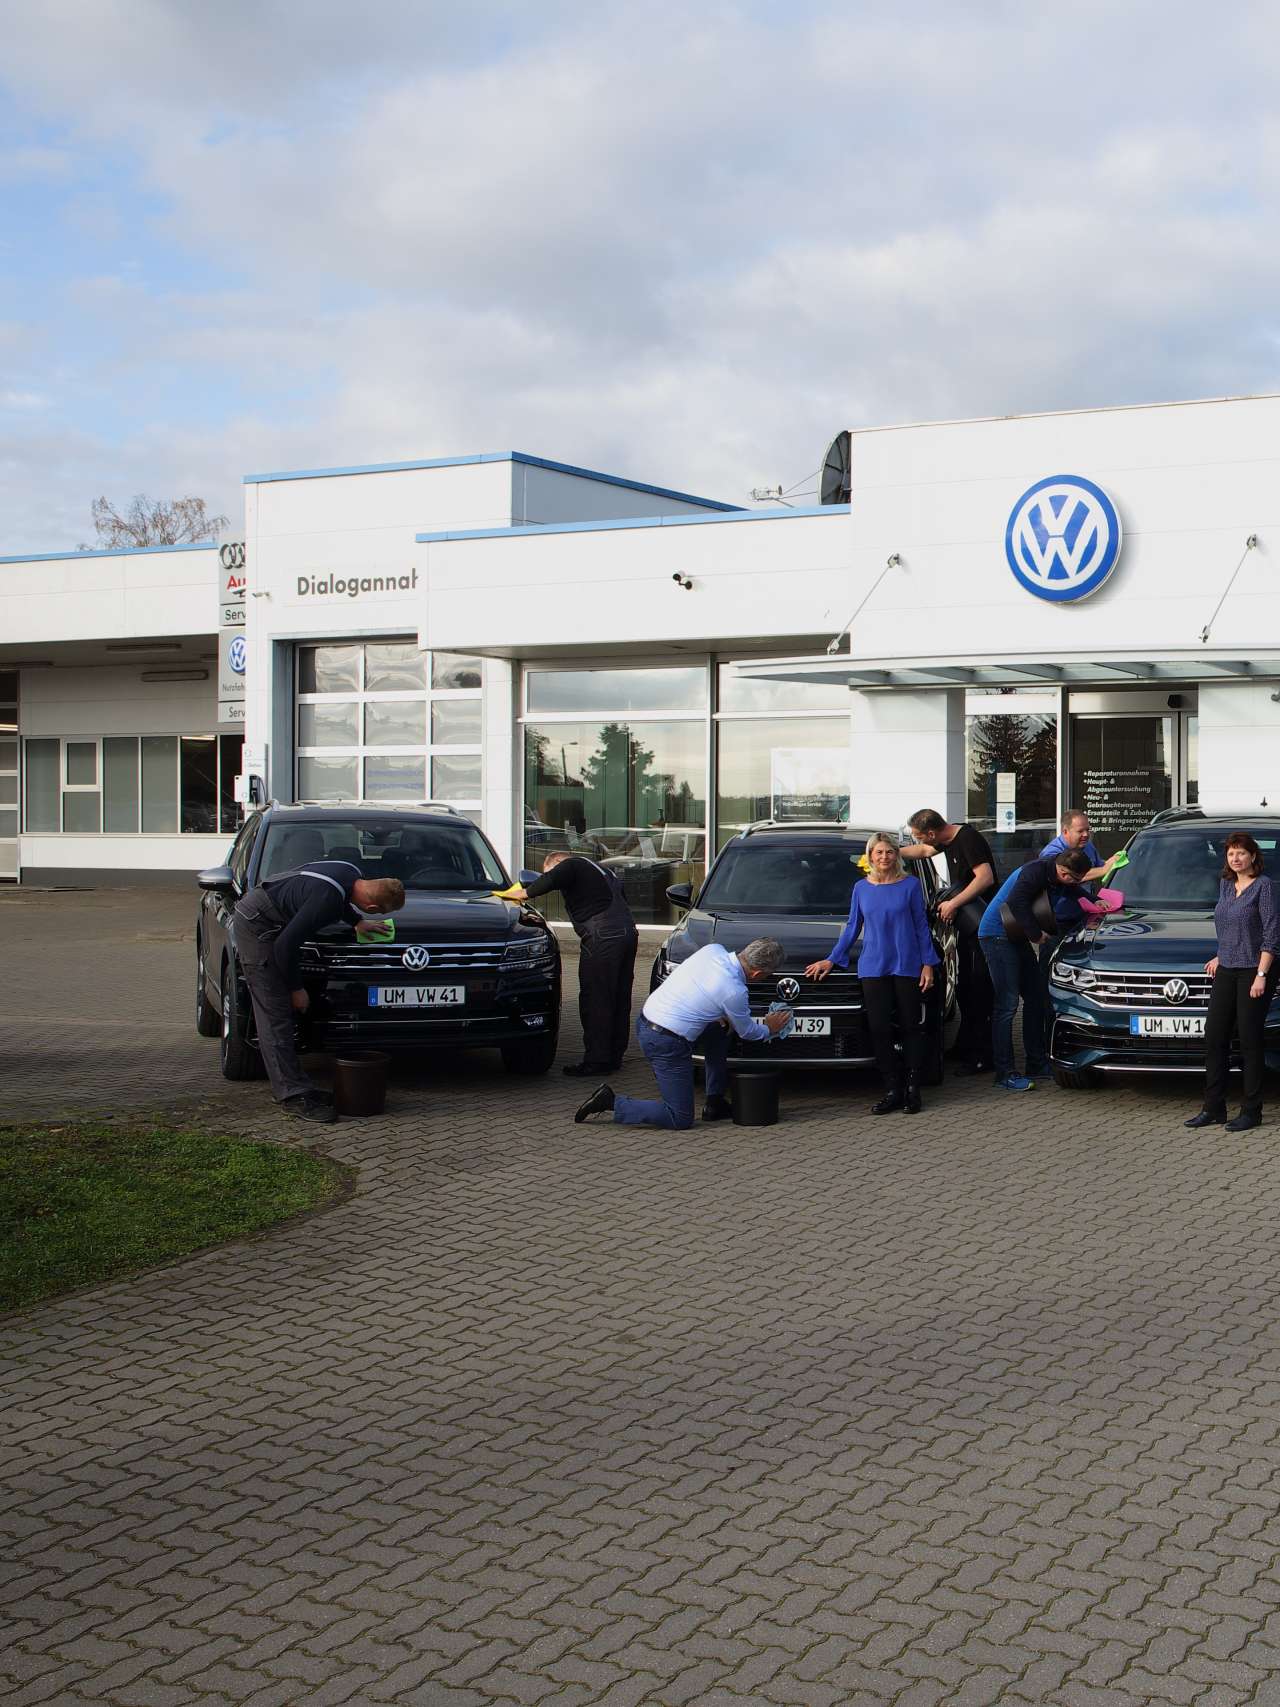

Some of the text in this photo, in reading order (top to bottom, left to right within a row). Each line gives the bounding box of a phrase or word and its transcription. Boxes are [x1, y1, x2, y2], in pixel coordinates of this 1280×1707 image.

[226, 575, 246, 590] Au
[297, 567, 419, 598] Dialogannah
[225, 609, 246, 621] Serv
[228, 706, 246, 718] Serv
[1087, 770, 1150, 778] Reparaturannahme
[1109, 817, 1149, 825] Bringservice
[384, 989, 405, 1003] UM
[416, 988, 436, 1003] VW
[440, 988, 458, 1002] 41
[807, 1019, 825, 1033] 39
[1144, 1018, 1203, 1033] UM VW 1
